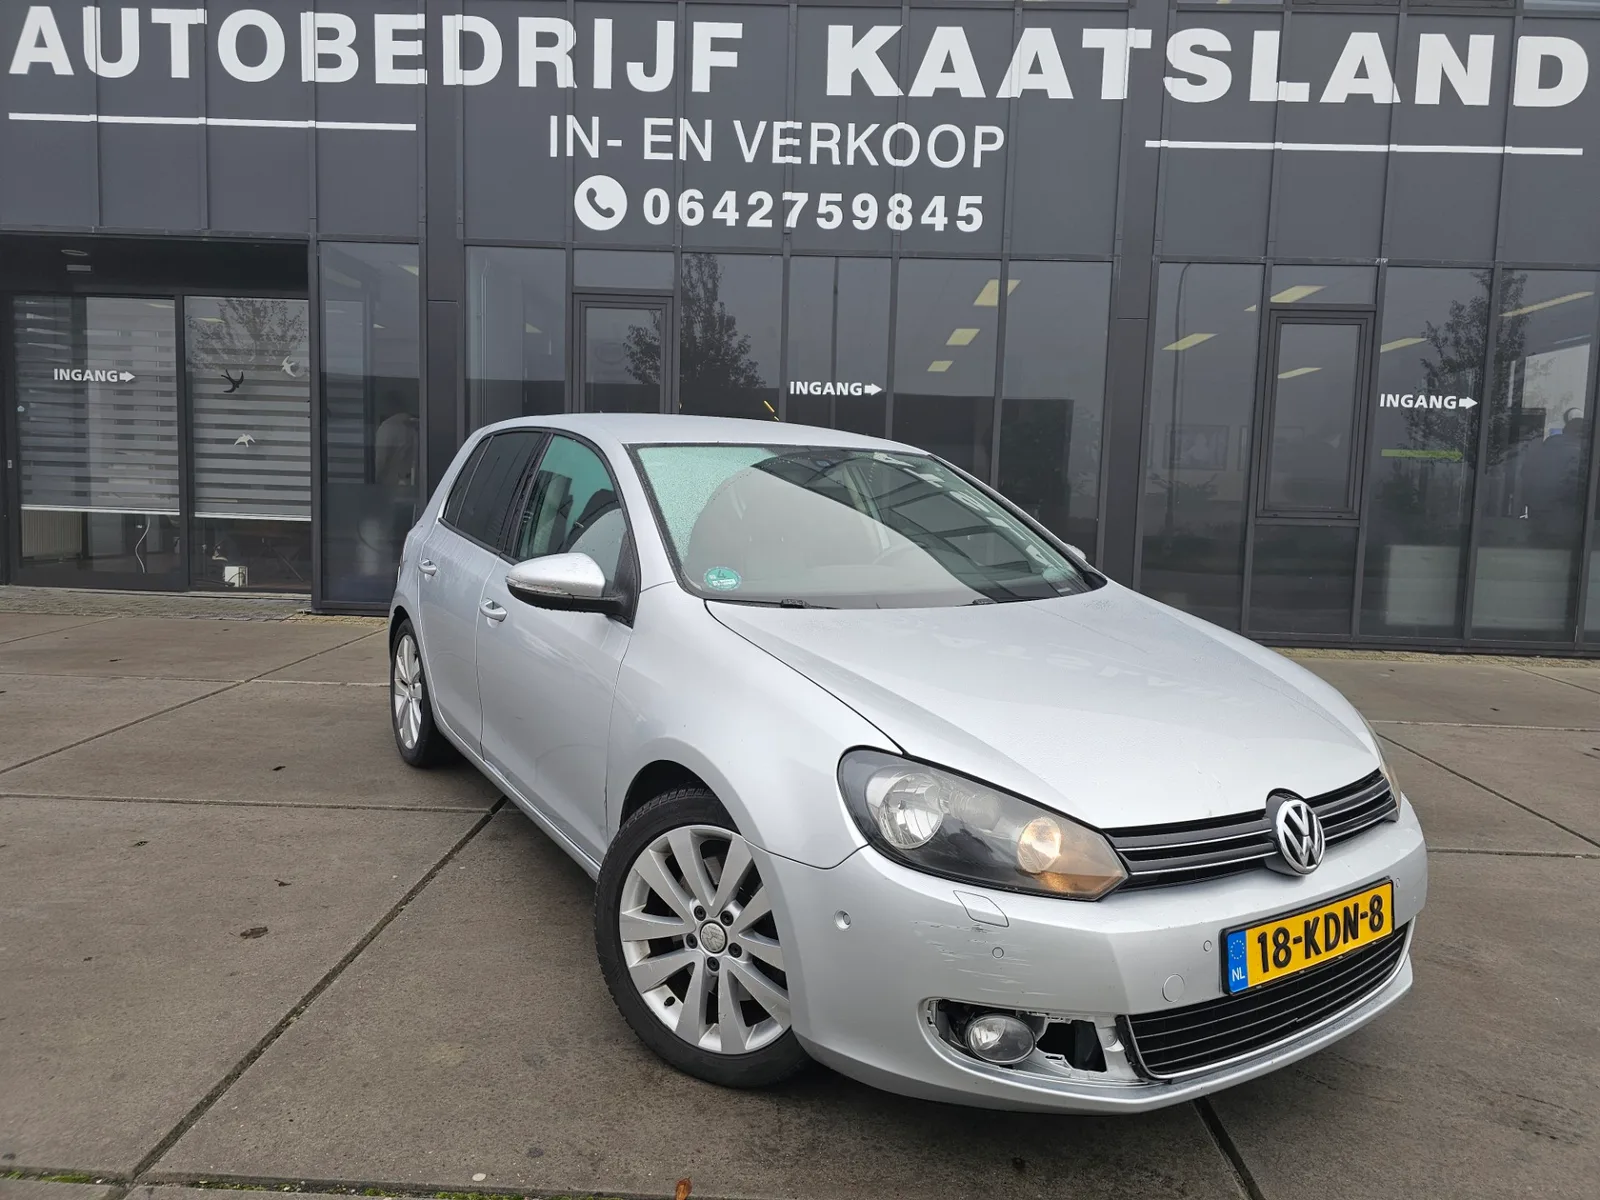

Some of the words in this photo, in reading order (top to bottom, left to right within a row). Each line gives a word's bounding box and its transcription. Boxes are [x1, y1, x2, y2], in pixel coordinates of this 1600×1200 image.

[9, 6, 743, 93] AUTOBEDRIJF
[826, 24, 1589, 107] KAATSLAND
[549, 114, 622, 158] IN-
[643, 117, 712, 162] EN
[733, 119, 1005, 168] VERKOOP
[643, 187, 983, 232] 0642759845
[53, 368, 118, 382] INGANG
[789, 381, 863, 396] INGANG
[1379, 393, 1457, 409] INGANG
[1257, 894, 1384, 973] 18-KDN-8
[1231, 967, 1246, 982] NL
